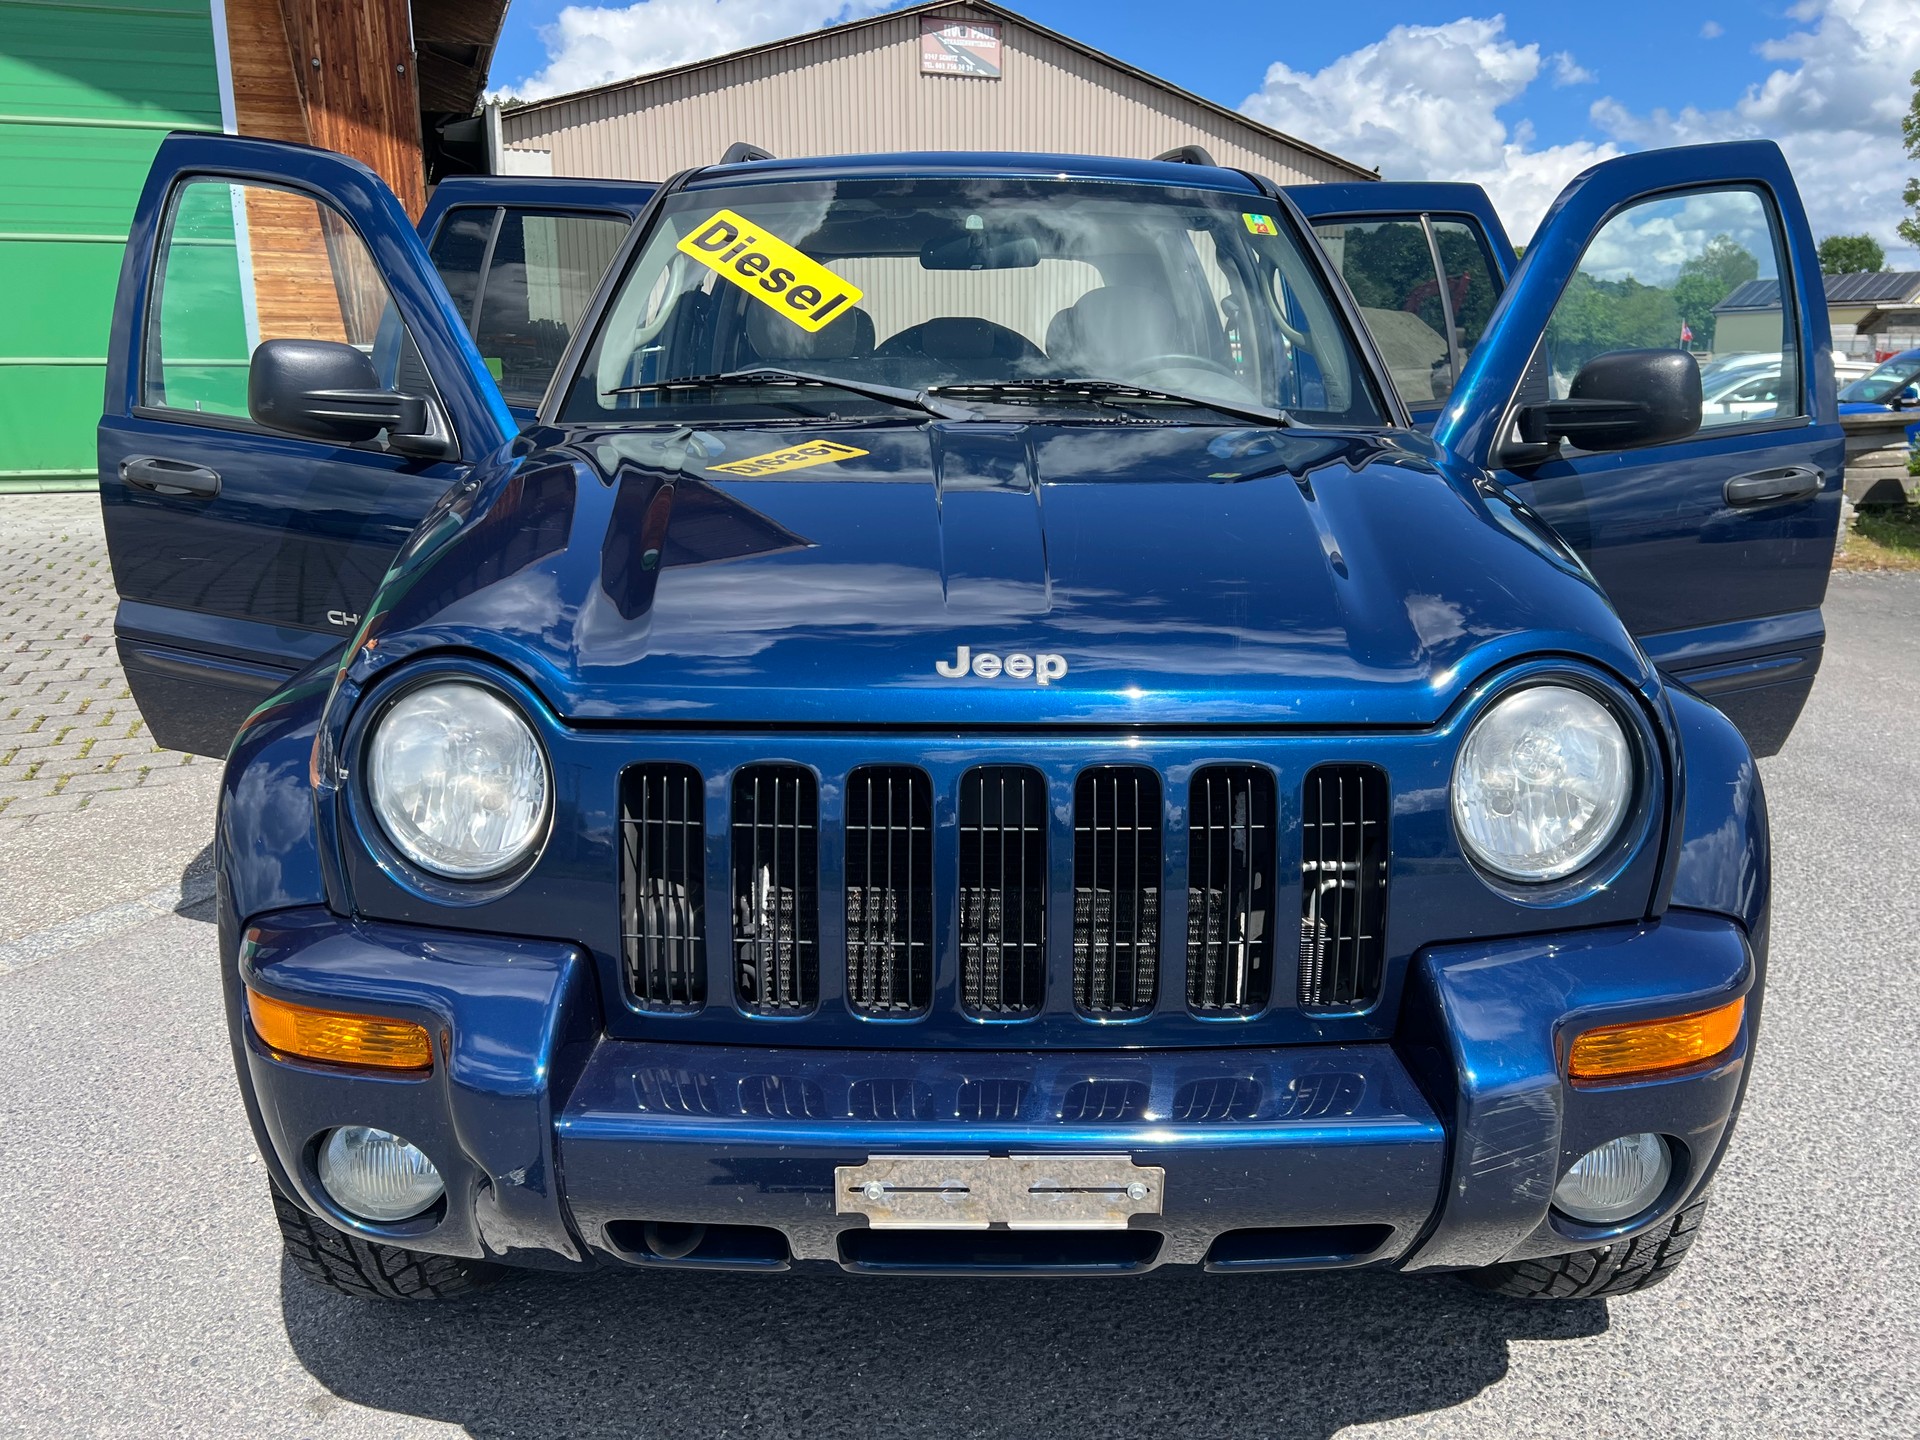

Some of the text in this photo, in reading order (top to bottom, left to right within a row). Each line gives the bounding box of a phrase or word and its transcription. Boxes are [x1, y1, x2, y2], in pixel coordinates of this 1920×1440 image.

[691, 219, 849, 322] Diesel
[327, 610, 361, 626] CH
[935, 645, 1068, 686] Jeep
